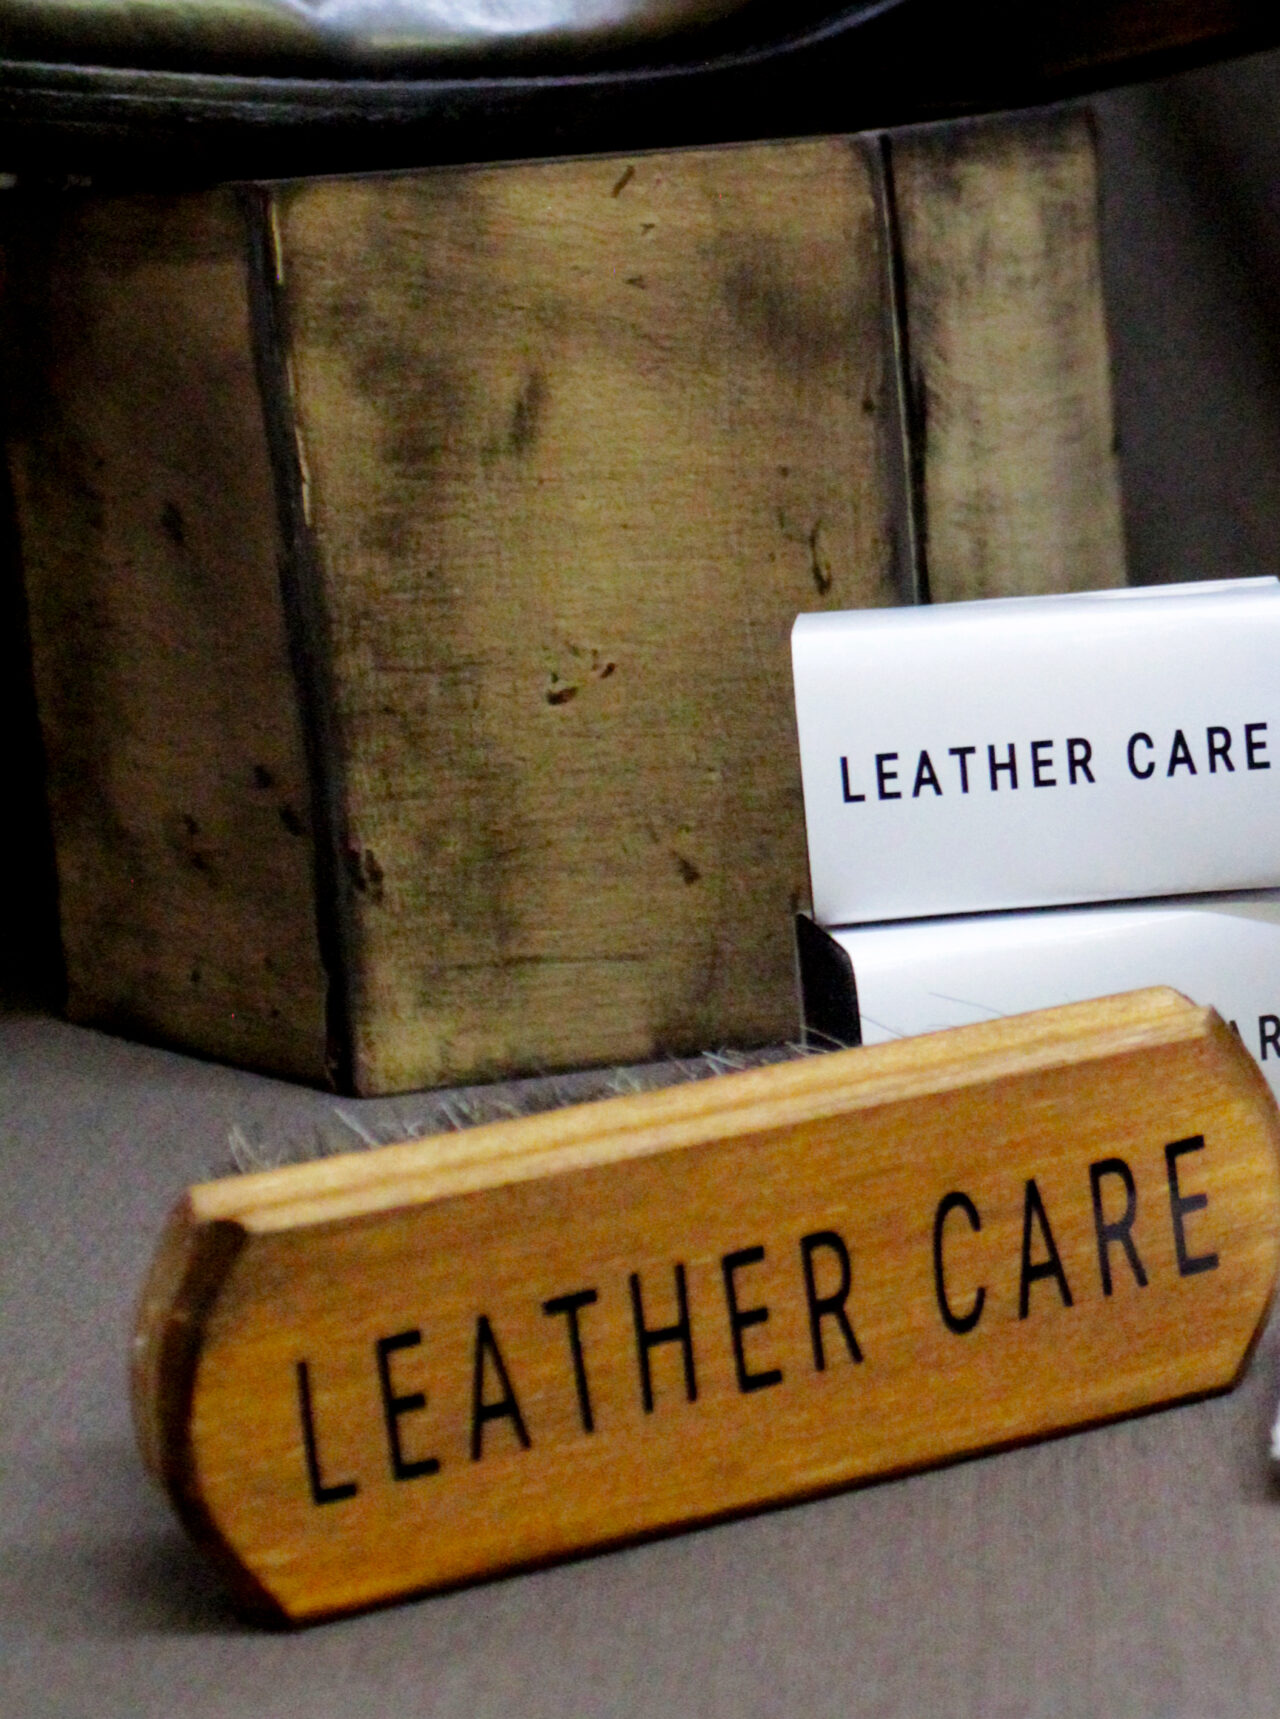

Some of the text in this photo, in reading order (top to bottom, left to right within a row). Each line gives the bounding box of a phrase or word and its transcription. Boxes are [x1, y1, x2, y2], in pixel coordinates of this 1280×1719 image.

[840, 722, 1271, 803] LEATHER CARE
[296, 1134, 1222, 1507] LEATHER CARE
